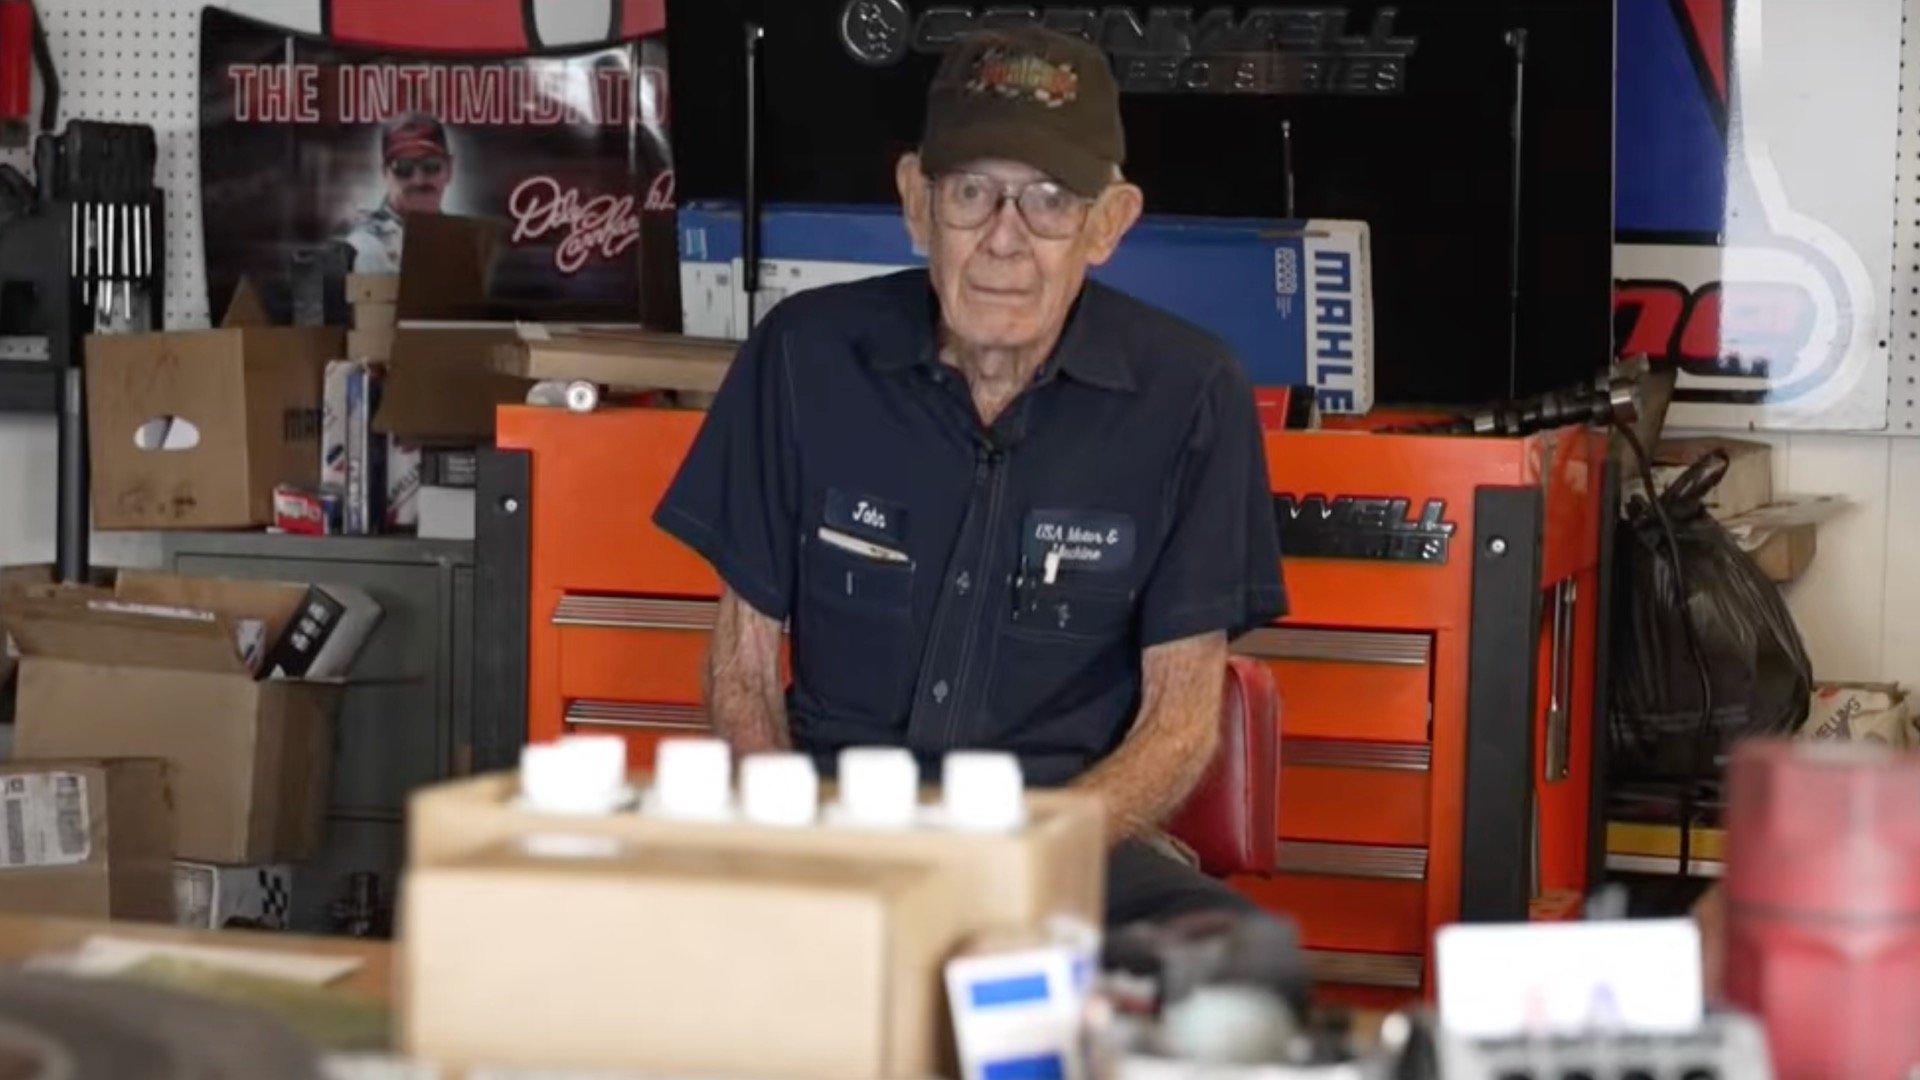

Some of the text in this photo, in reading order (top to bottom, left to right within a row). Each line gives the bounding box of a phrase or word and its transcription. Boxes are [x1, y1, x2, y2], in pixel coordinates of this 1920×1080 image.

[227, 64, 320, 123] THE
[1233, 61, 1399, 92] SERIES
[1314, 251, 1354, 411] MAHLE
[1035, 523, 1063, 542] USA
[1106, 528, 1119, 545] &
